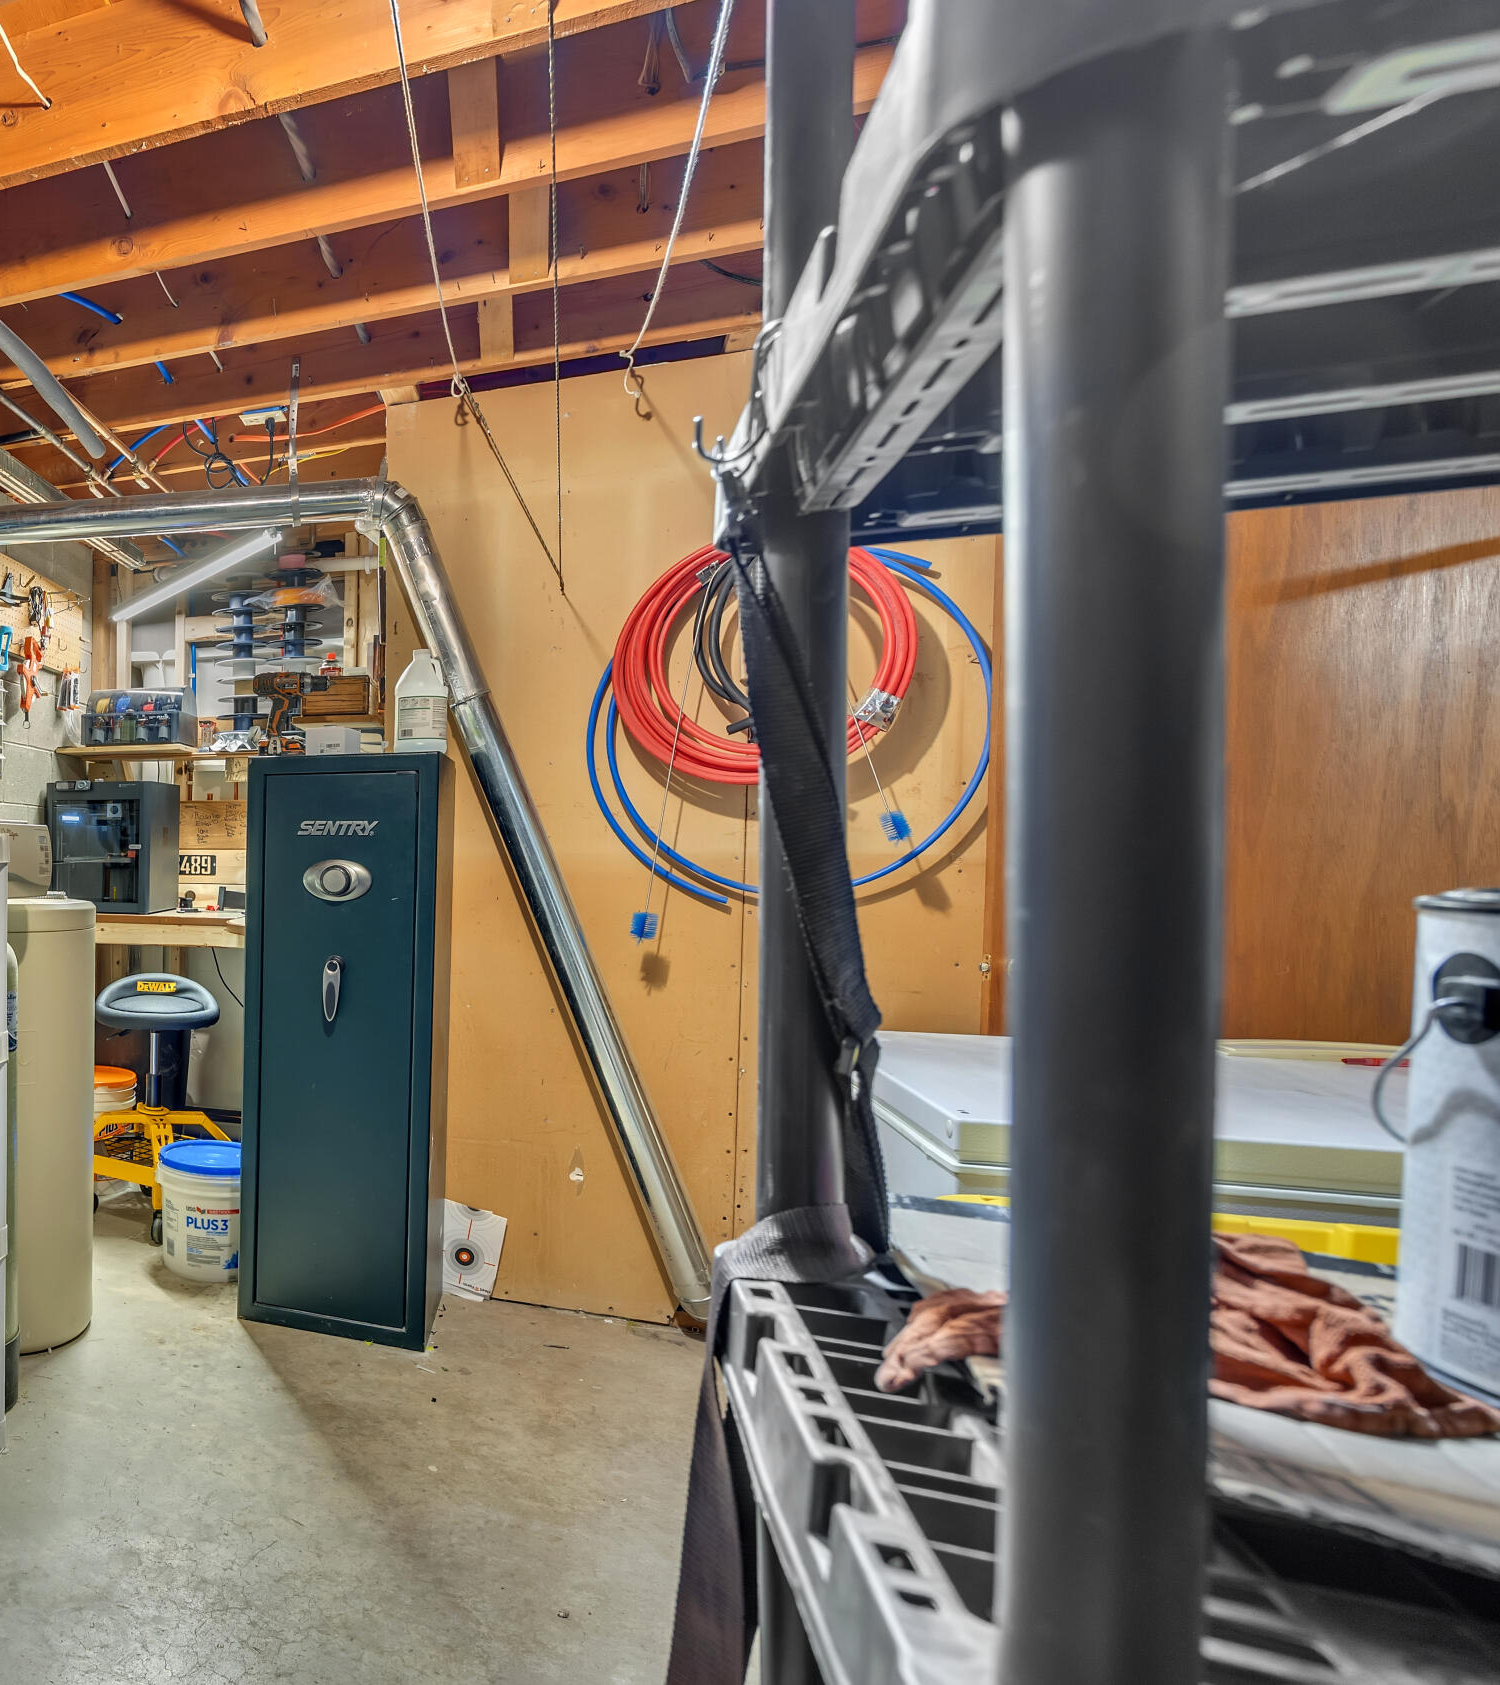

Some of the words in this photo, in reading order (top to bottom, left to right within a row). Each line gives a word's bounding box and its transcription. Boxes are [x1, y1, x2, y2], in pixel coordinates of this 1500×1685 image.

[297, 820, 379, 836] SENTRY
[186, 1216, 219, 1231] PLUS
[220, 1219, 229, 1231] 3
